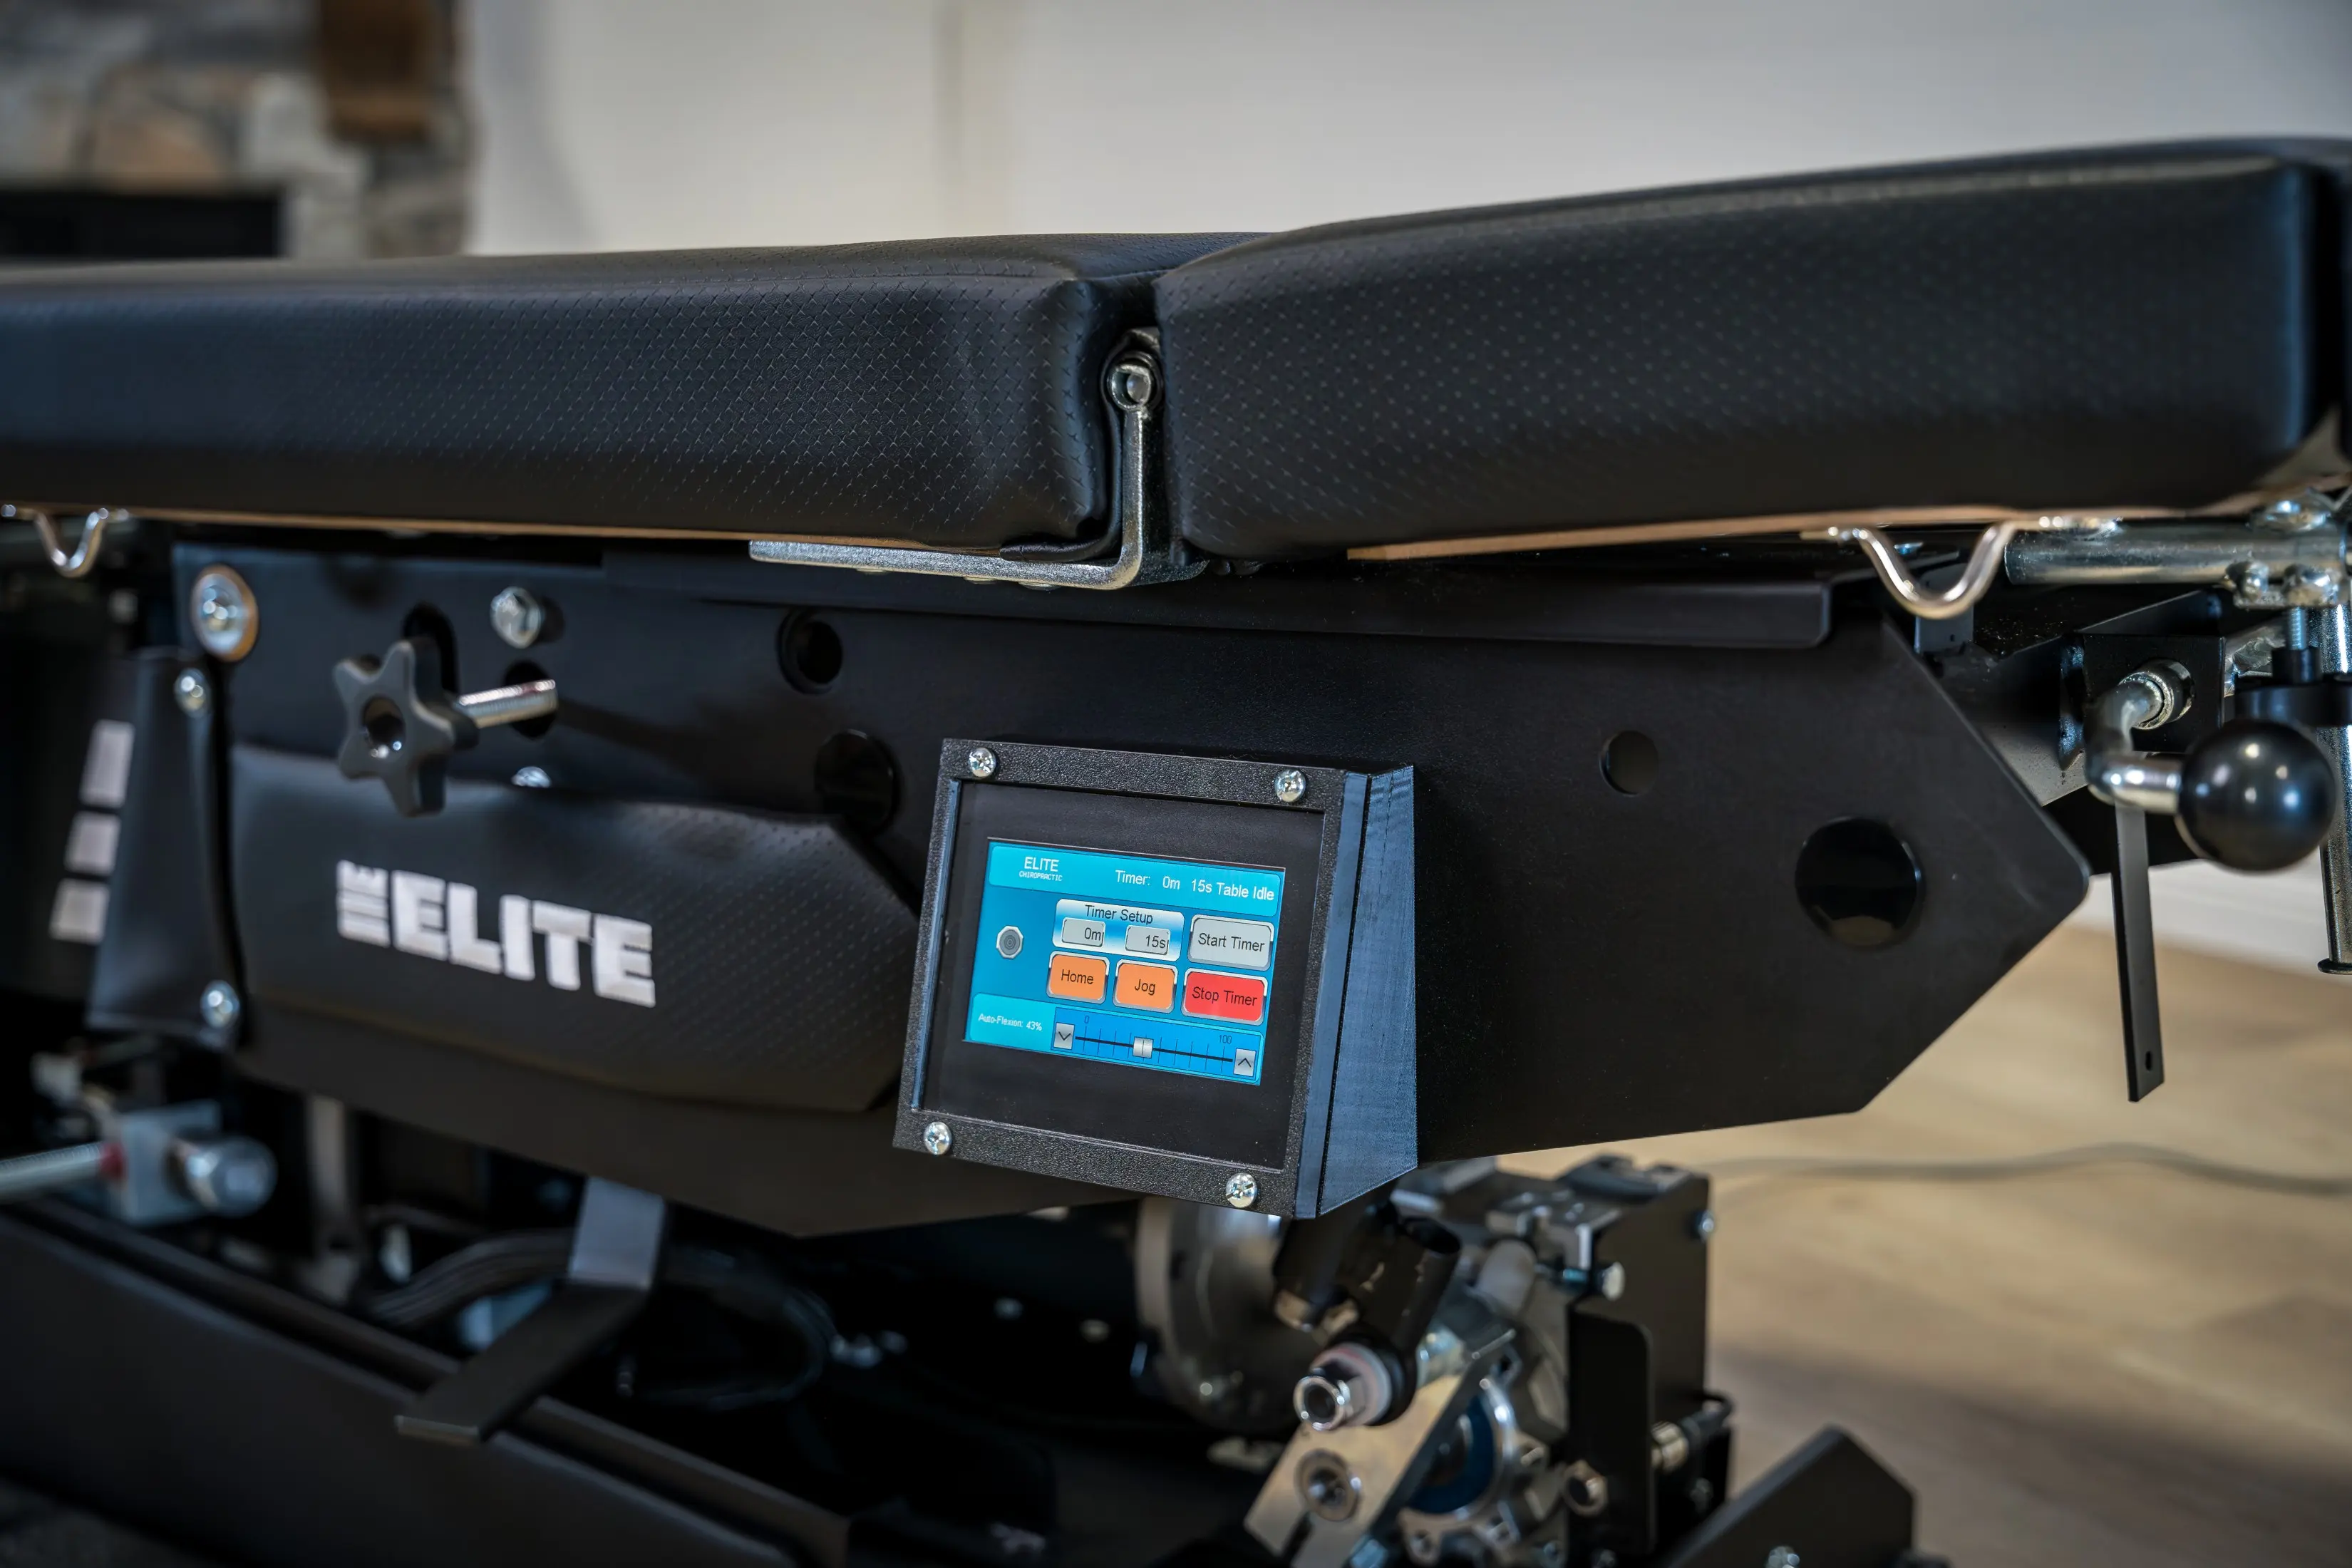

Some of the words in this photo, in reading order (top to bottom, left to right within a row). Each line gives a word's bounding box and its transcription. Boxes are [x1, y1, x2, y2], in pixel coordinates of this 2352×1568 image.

[1024, 857, 1059, 872] ELITE
[1019, 871, 1063, 882] CHIROPRACTIC
[1162, 876, 1180, 890] 0m
[1191, 879, 1212, 893] 15s
[1216, 882, 1249, 898] Table
[1253, 886, 1274, 901] Idle
[1085, 905, 1117, 920] Timer
[1120, 909, 1153, 925] Setup
[391, 870, 656, 1008] ELITE
[1084, 927, 1102, 942] 0m
[1145, 935, 1166, 949] 15s
[1198, 933, 1226, 949] Start
[1232, 937, 1264, 952] Timer
[1061, 970, 1093, 985] Home
[1134, 980, 1155, 995] Jog
[1192, 986, 1219, 1003] Stop
[1224, 991, 1257, 1006] Timer
[1026, 1020, 1042, 1031] 43%
[1084, 1016, 1089, 1024] 0
[1219, 1035, 1232, 1044] 100
